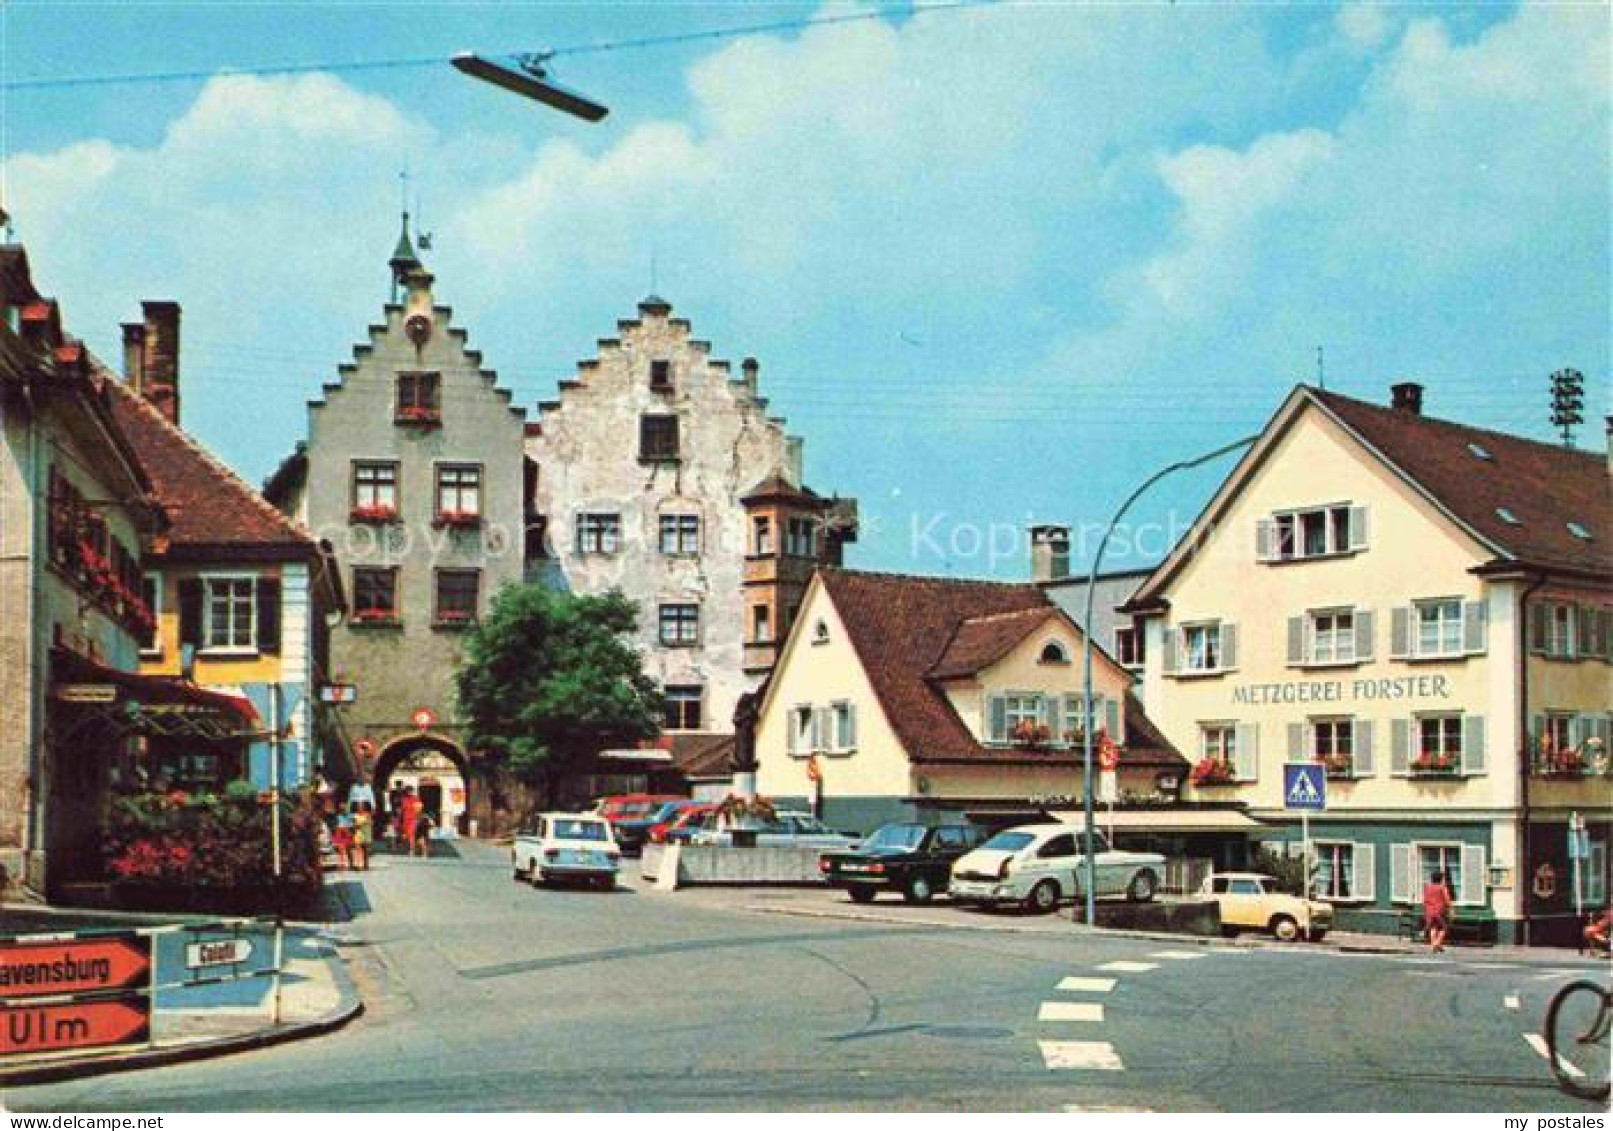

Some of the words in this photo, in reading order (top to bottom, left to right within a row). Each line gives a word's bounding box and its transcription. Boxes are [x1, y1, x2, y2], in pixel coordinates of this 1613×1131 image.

[1232, 681, 1342, 703] METZGEREI
[1354, 674, 1449, 699] FORSTER
[9, 1011, 89, 1044] Ulm
